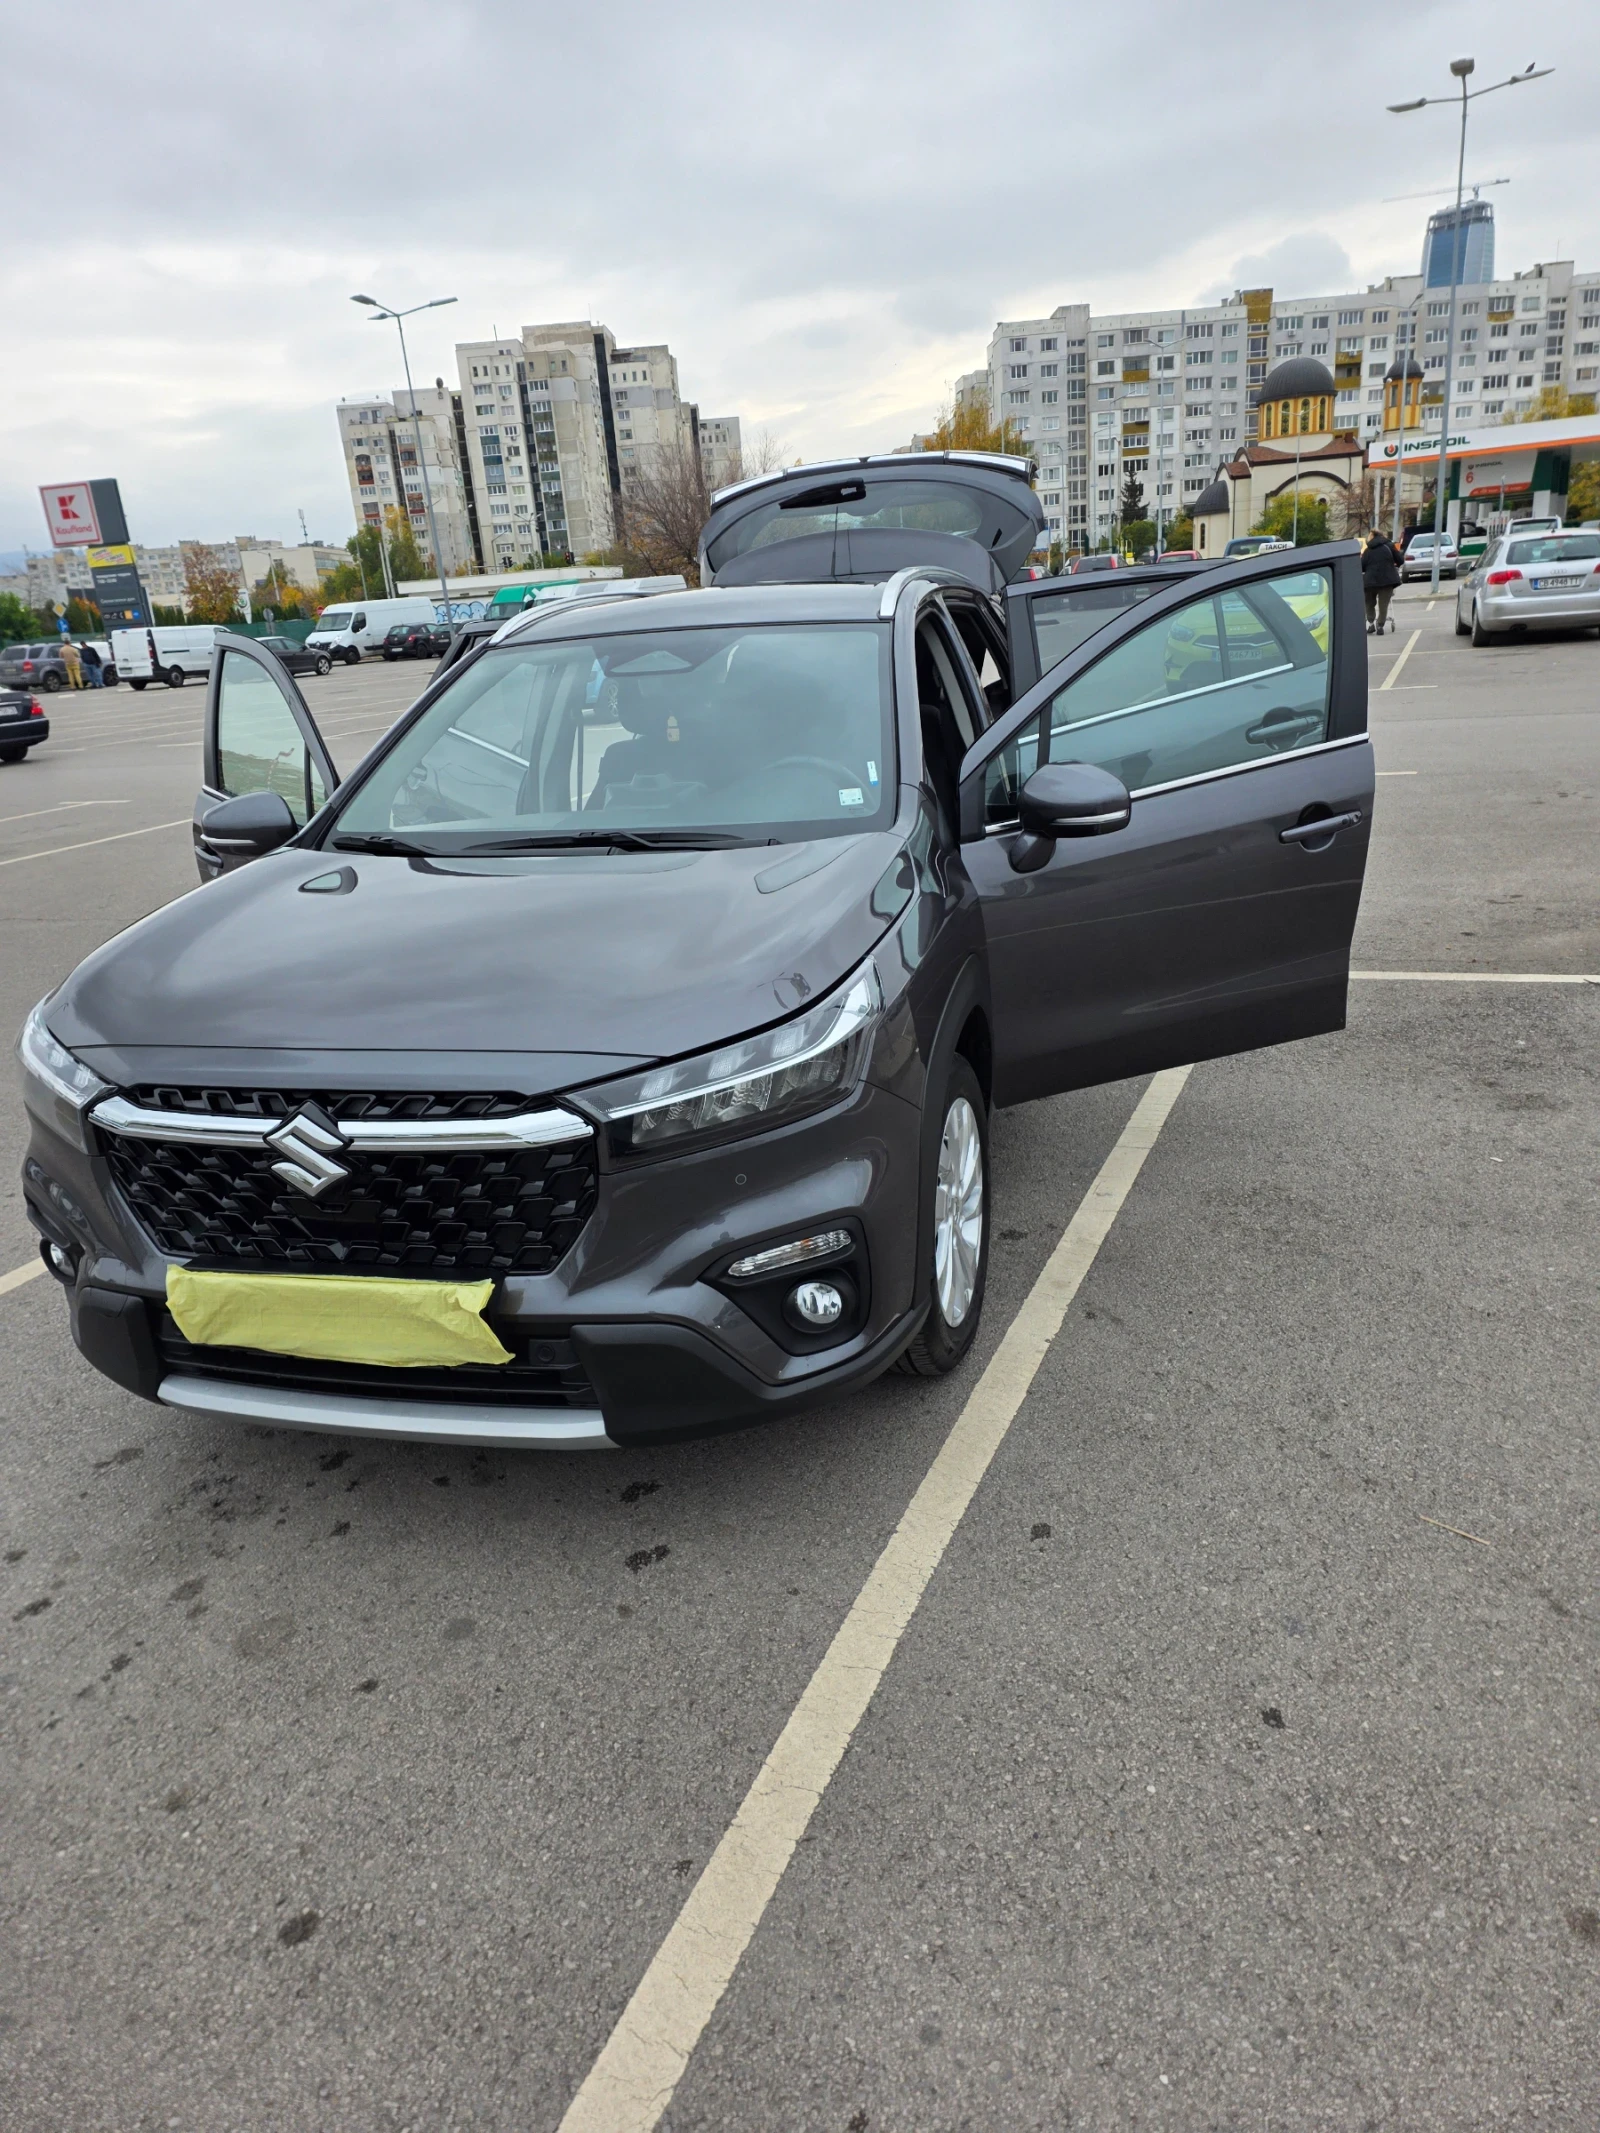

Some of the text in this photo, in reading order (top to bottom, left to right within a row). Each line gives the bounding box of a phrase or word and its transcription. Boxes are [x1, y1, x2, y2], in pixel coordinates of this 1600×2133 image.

[1465, 471, 1474, 484] 6
[56, 524, 92, 535] Kaufland
[1265, 543, 1288, 551] ТАКСИ
